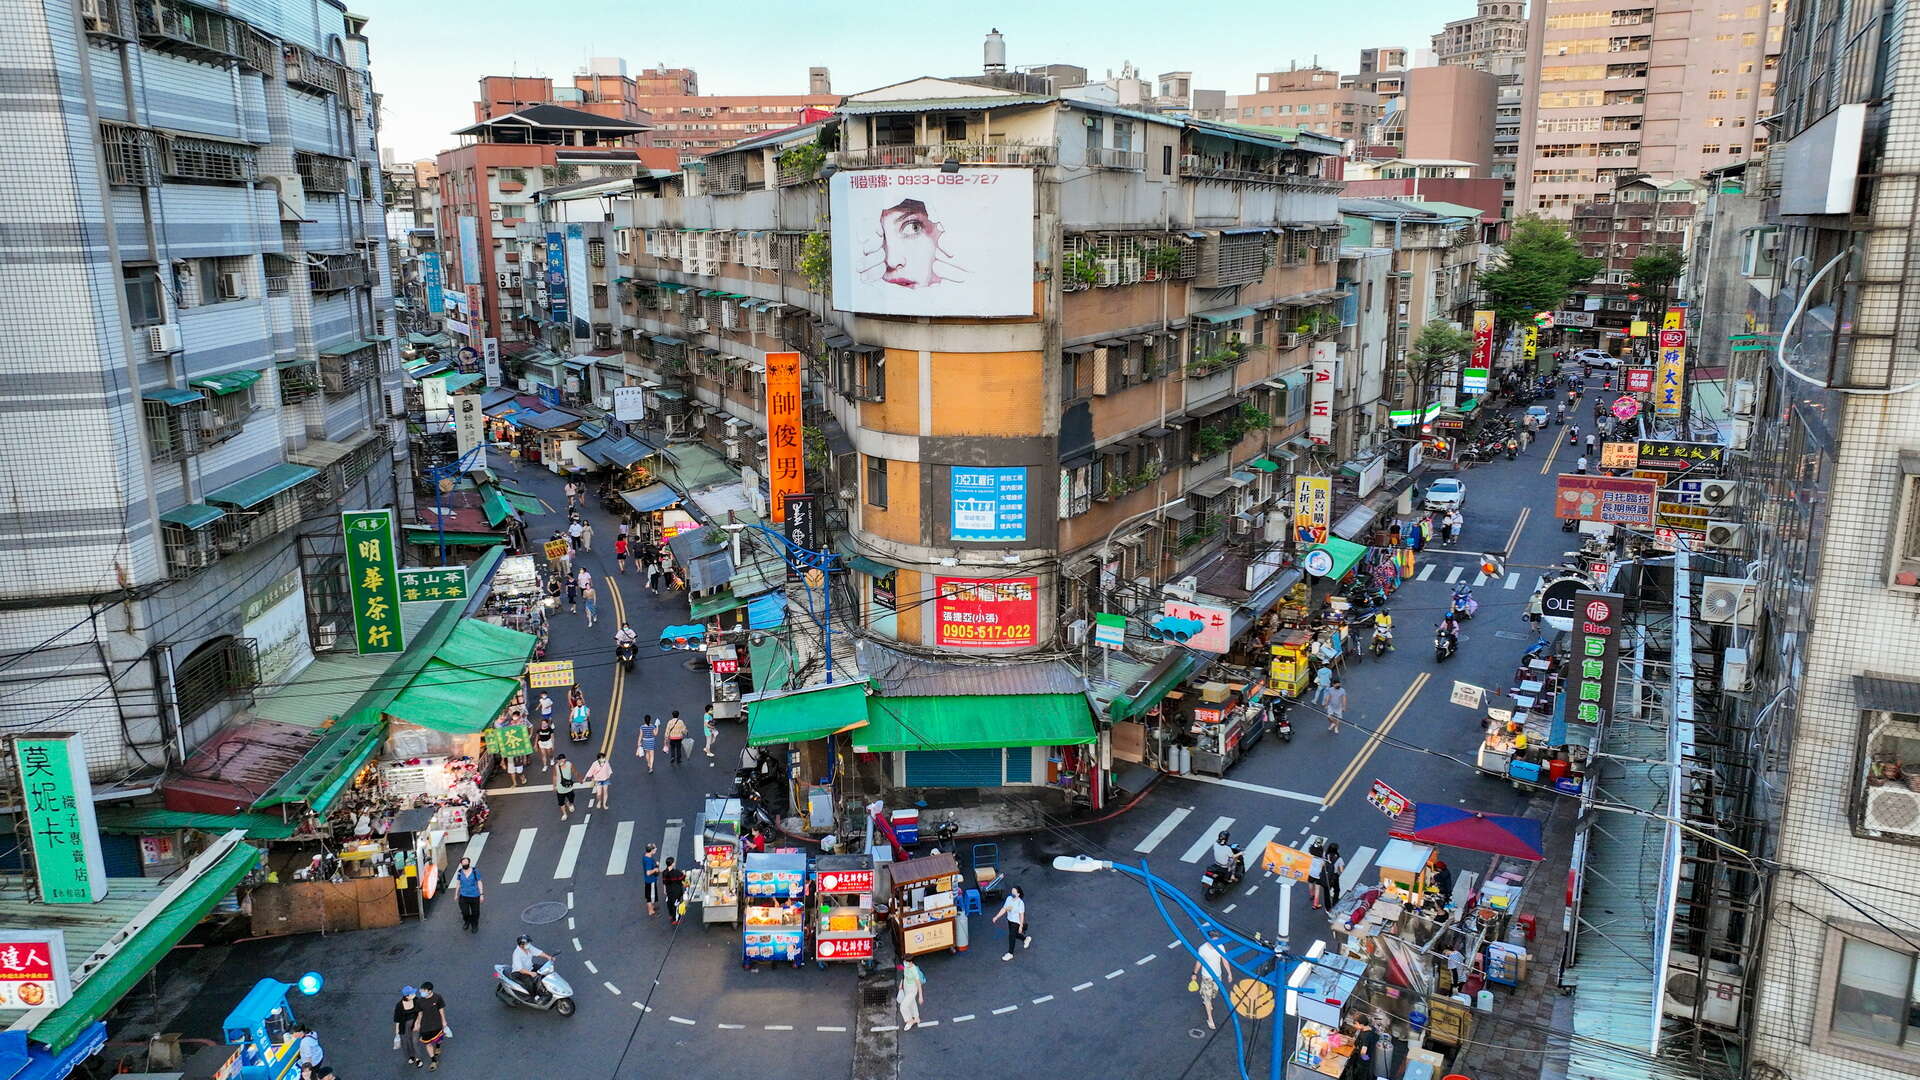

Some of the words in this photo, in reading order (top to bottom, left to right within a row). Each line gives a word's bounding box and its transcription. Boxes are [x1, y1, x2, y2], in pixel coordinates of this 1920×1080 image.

[897, 174, 1000, 186] 0933-092-727
[1640, 443, 1722, 461] 創世紀紋身
[357, 520, 379, 530] 明華
[402, 572, 462, 586] 高山茶
[358, 538, 393, 648] 明華茶行
[403, 586, 463, 601] 普洱茶
[1586, 601, 1609, 622] 福
[943, 624, 1031, 639] 0905-517-022
[1583, 622, 1612, 636] Bliss
[1577, 636, 1606, 724] 百貨廣場
[505, 729, 523, 749] 茶
[23, 746, 66, 850] 莫妮卡
[0, 945, 49, 971] 達人
